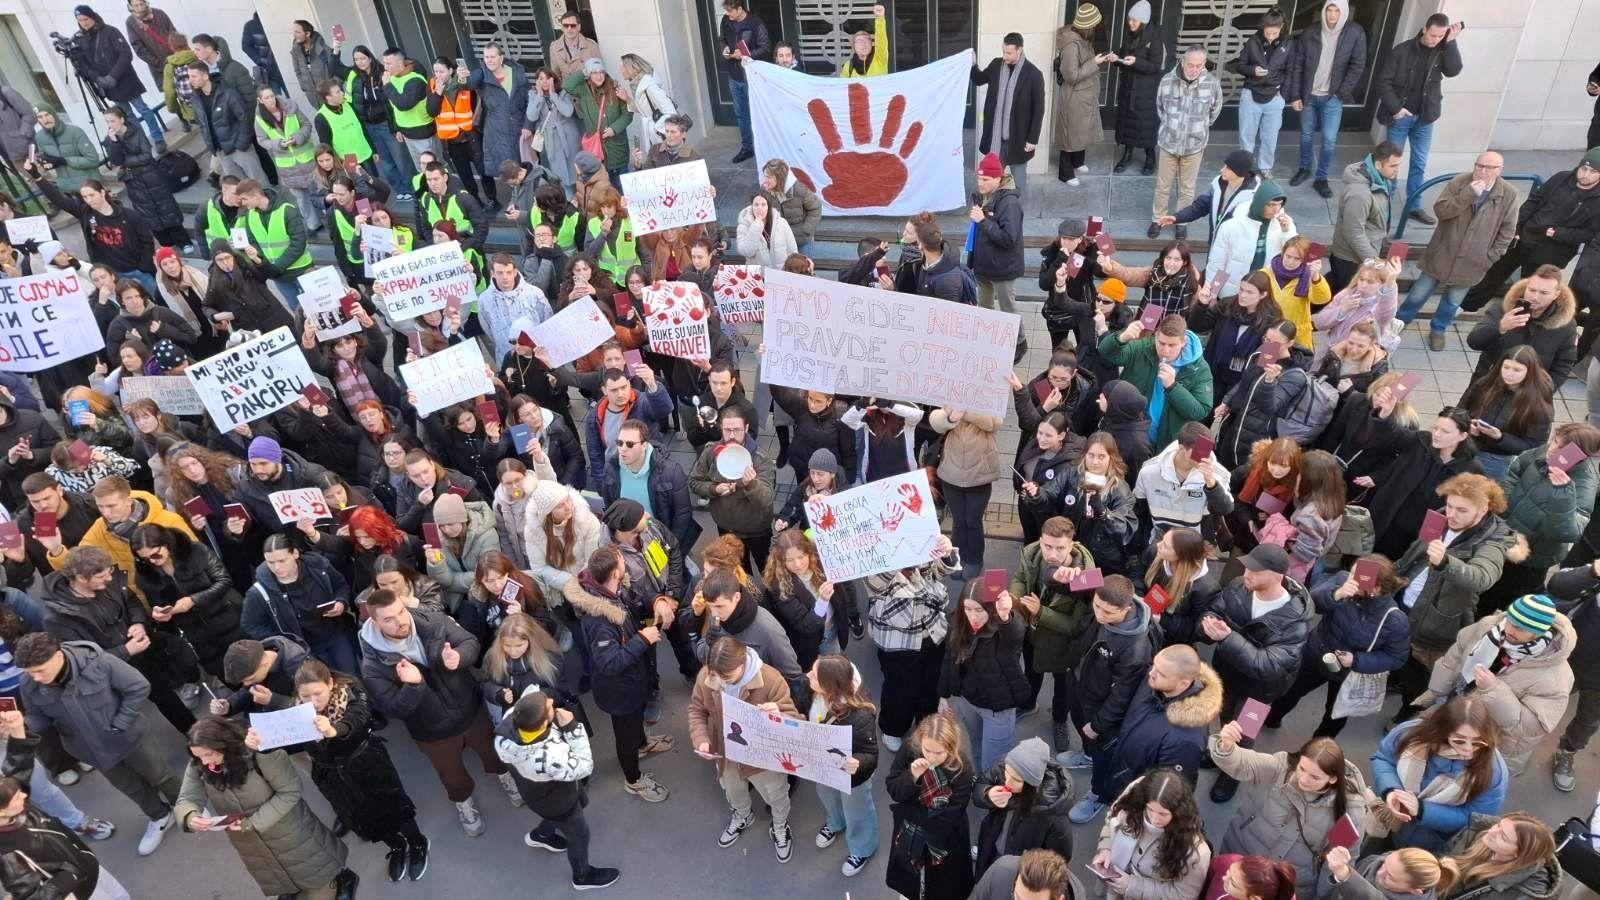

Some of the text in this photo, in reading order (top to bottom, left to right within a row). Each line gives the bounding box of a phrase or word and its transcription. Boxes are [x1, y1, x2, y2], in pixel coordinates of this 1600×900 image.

[376, 250, 460, 281] НЕ БИ БИЛО ОВЕ
[19, 275, 80, 302] СЛУЧАЈ
[382, 275, 420, 297] КРВИ
[388, 280, 470, 313] СВЕ ПО ЗАКОНУ
[31, 304, 58, 324] СЕ
[721, 301, 740, 314] RUKE
[741, 300, 752, 311] SU
[724, 310, 764, 325] KRVAV
[766, 282, 1016, 348] TAMO GDE NEMA
[651, 323, 705, 341] RUKE SU VAM
[653, 335, 707, 356] KRVAVE!
[192, 333, 286, 381] MI SMO OVDE U
[776, 318, 999, 385] PRAVDE OTPOR
[764, 350, 890, 394] POSTAJE
[225, 374, 305, 424] PANCIRU
